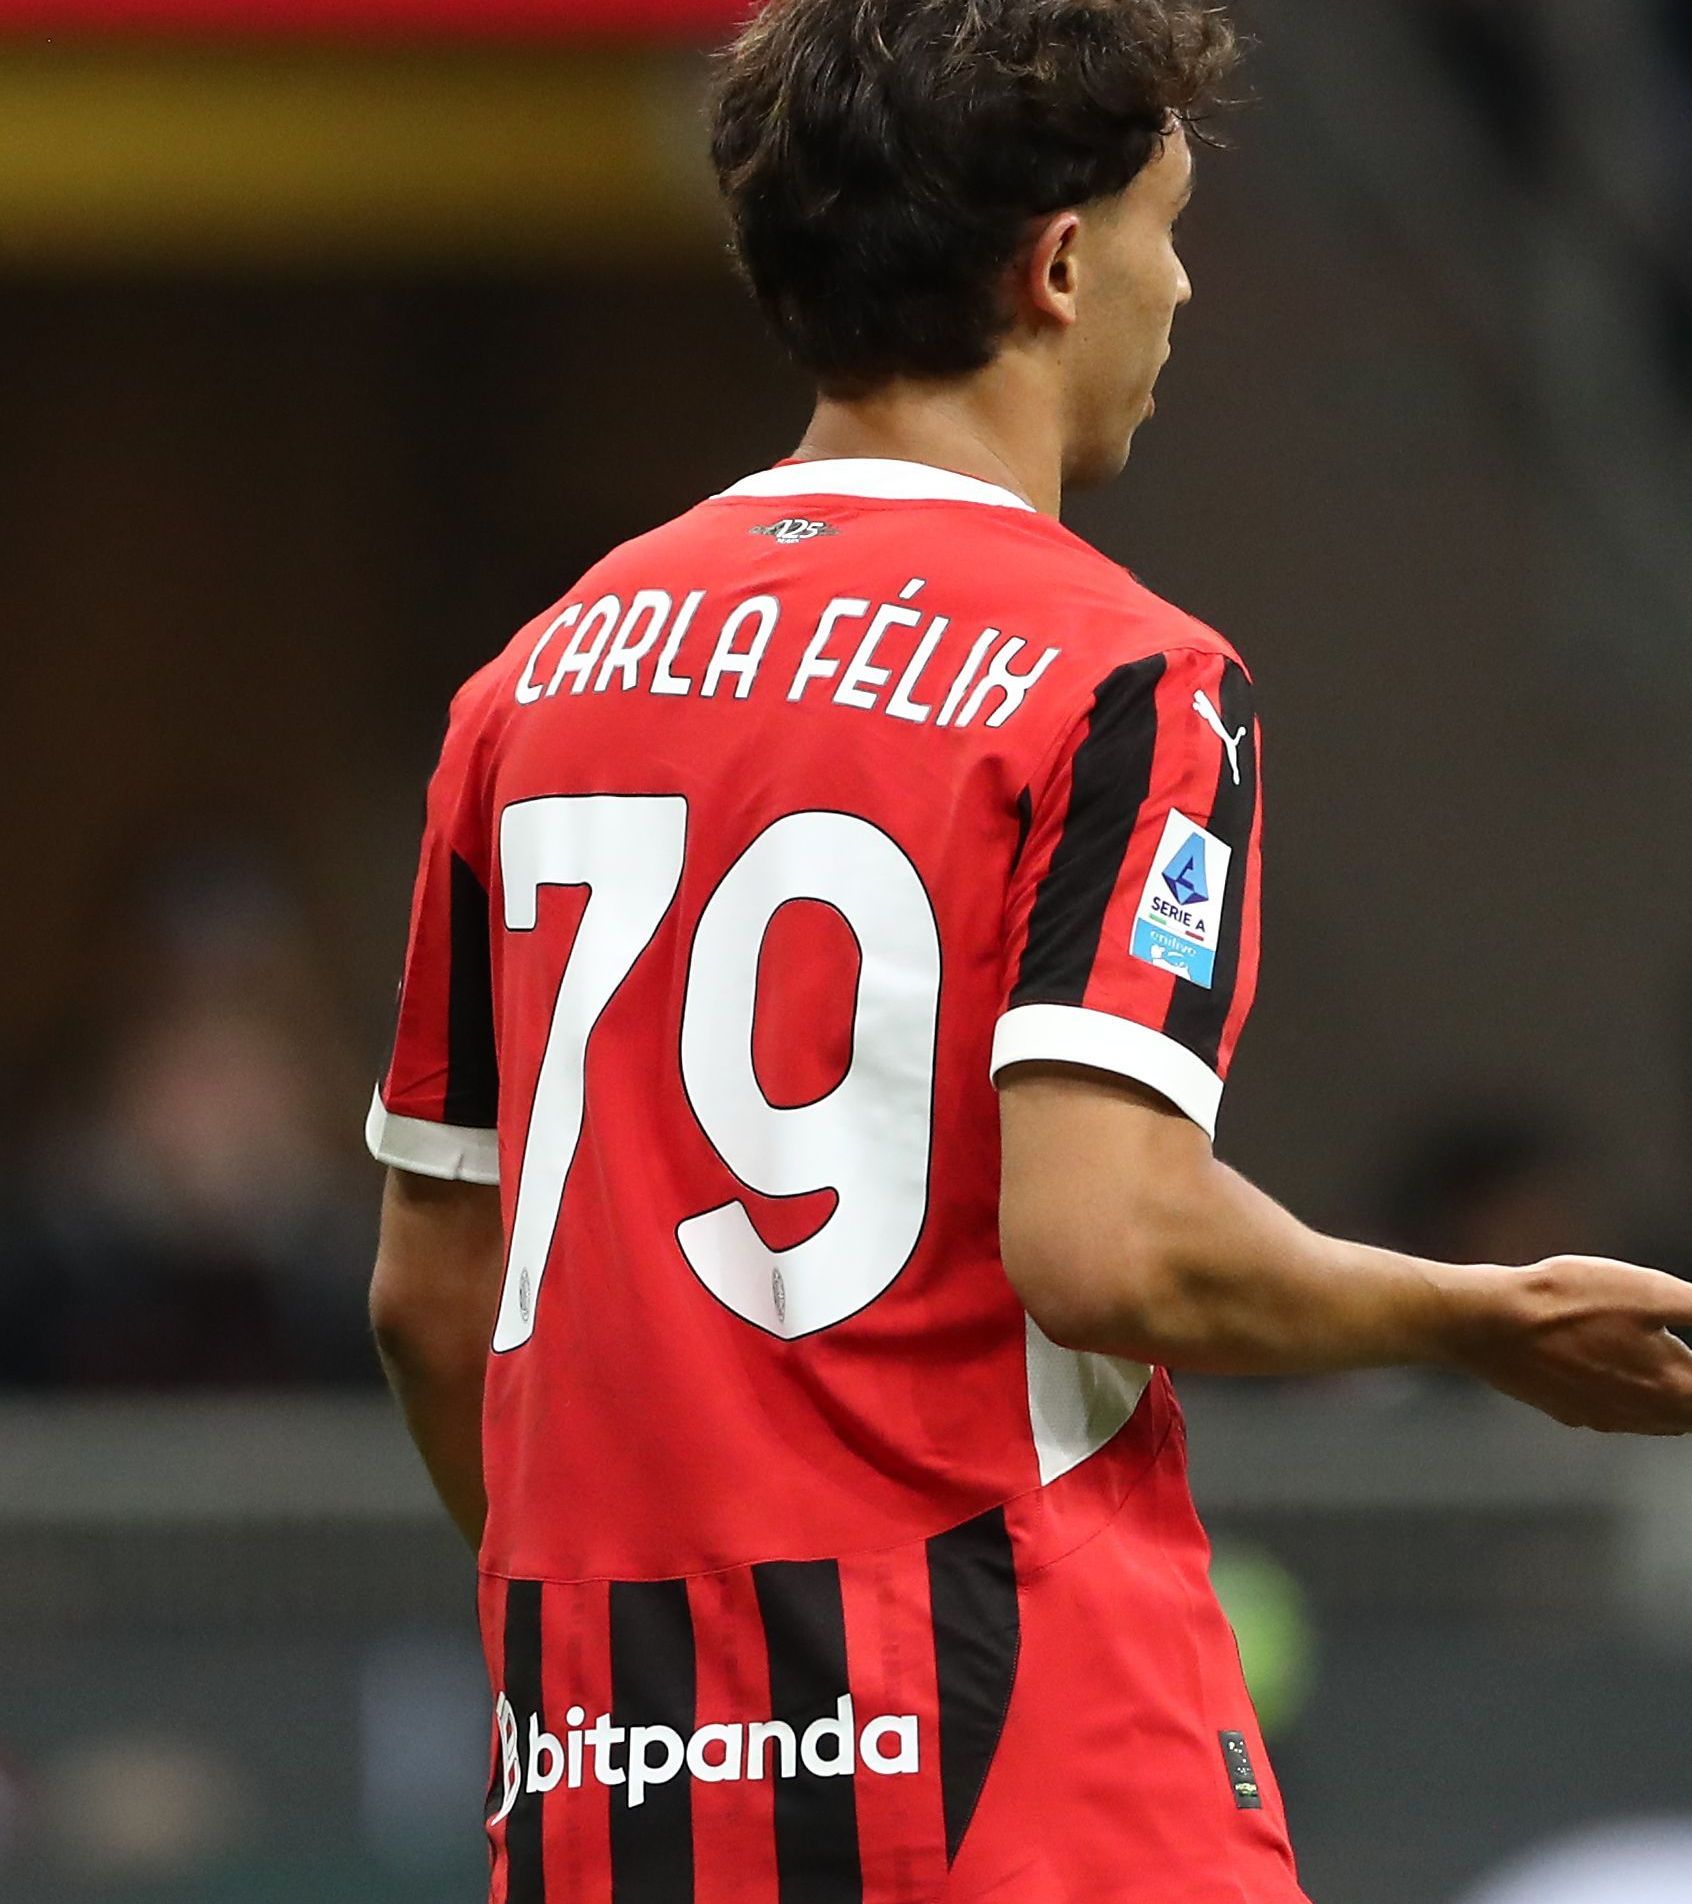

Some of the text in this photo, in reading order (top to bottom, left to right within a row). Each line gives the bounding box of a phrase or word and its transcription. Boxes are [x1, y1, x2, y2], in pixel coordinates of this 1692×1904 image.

[776, 519, 824, 539] 125
[514, 578, 1061, 728] CARLA FÉLIX
[1151, 897, 1206, 933] SERIE A
[492, 792, 942, 1353] 79
[526, 1693, 919, 1808] bitpanda
